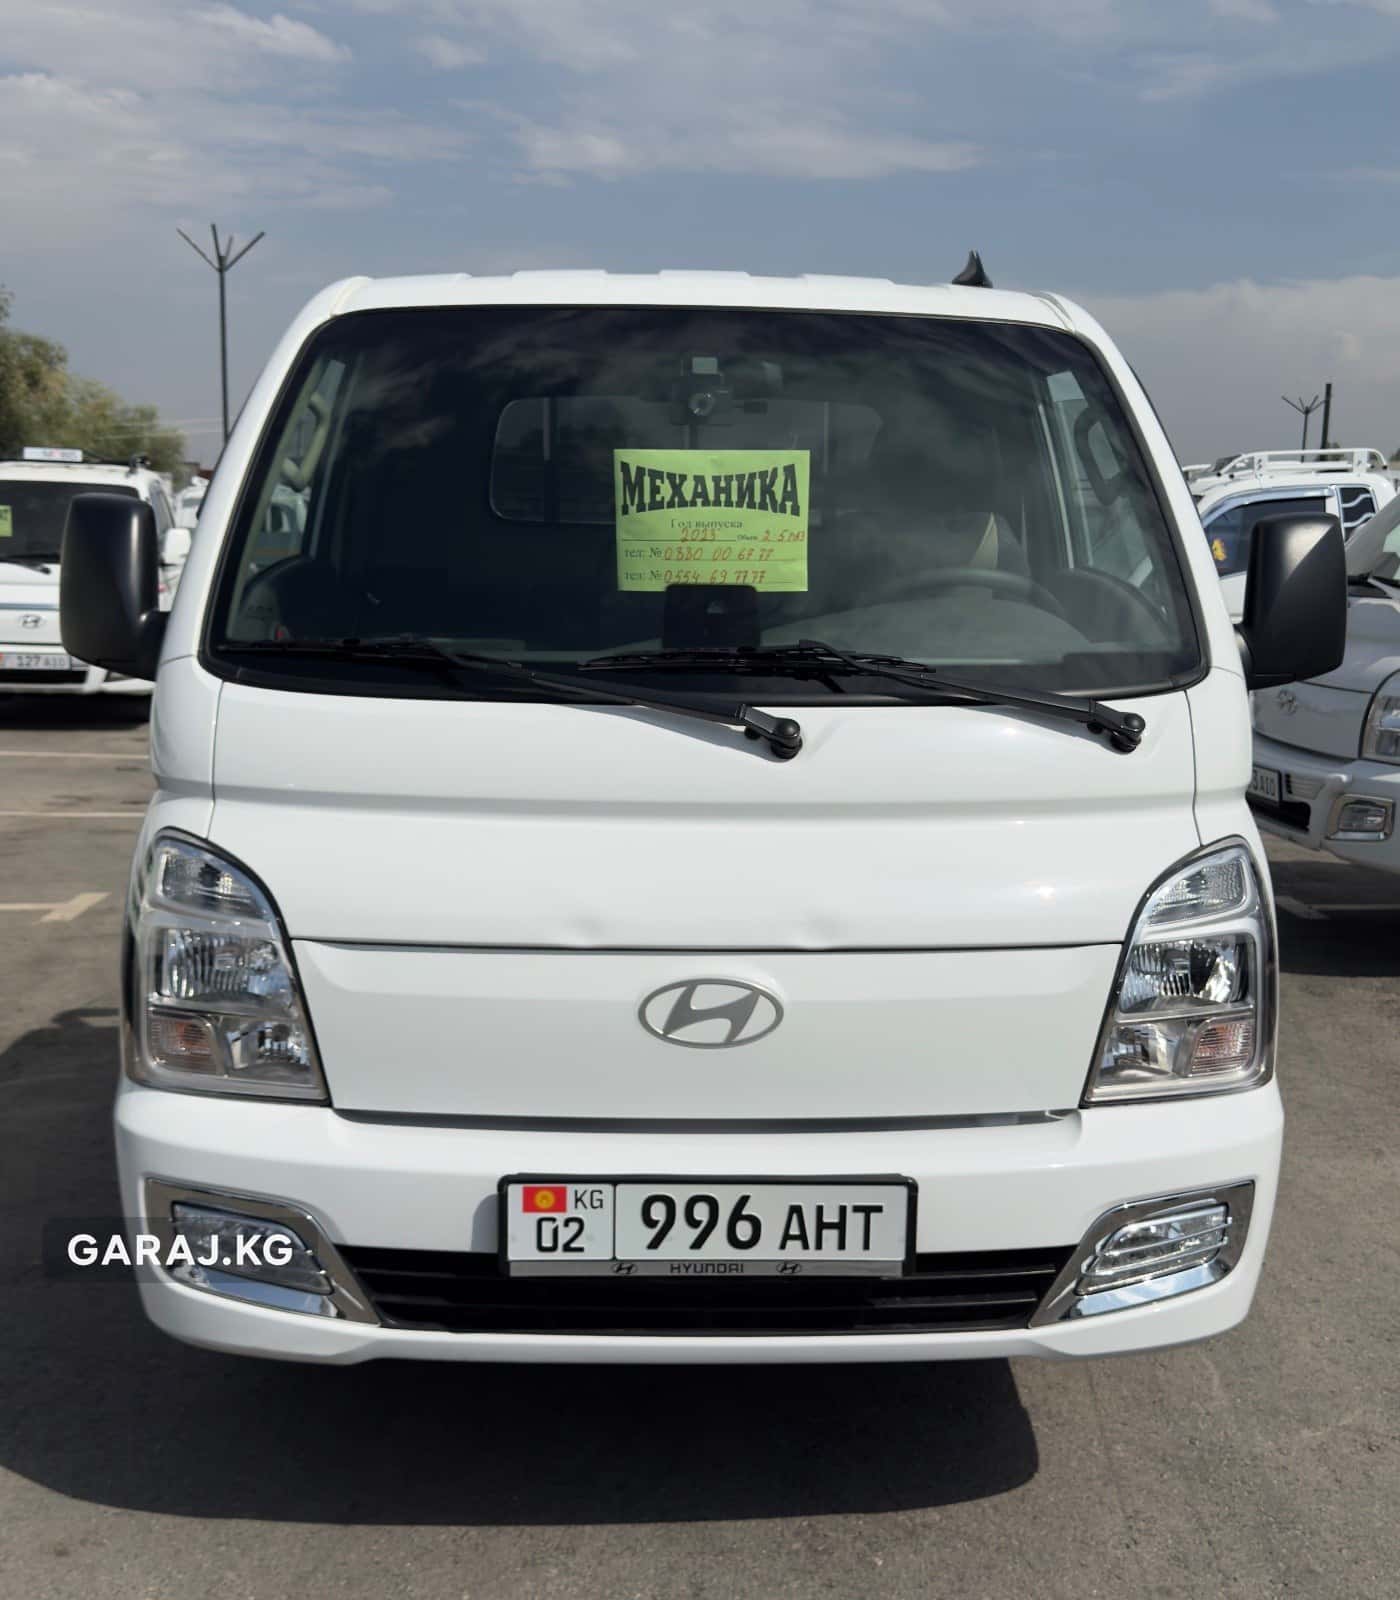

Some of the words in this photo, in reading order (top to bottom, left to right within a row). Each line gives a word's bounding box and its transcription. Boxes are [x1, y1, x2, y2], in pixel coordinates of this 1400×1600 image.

[620, 461, 800, 517] МЕХАНИКА
[670, 519, 689, 530] Год
[694, 520, 743, 531] выпуска
[536, 1216, 586, 1254] 02
[573, 1189, 604, 1210] KG
[640, 1194, 762, 1251] 996
[778, 1204, 884, 1251] AHT
[670, 1262, 744, 1275] HYUNDAI
